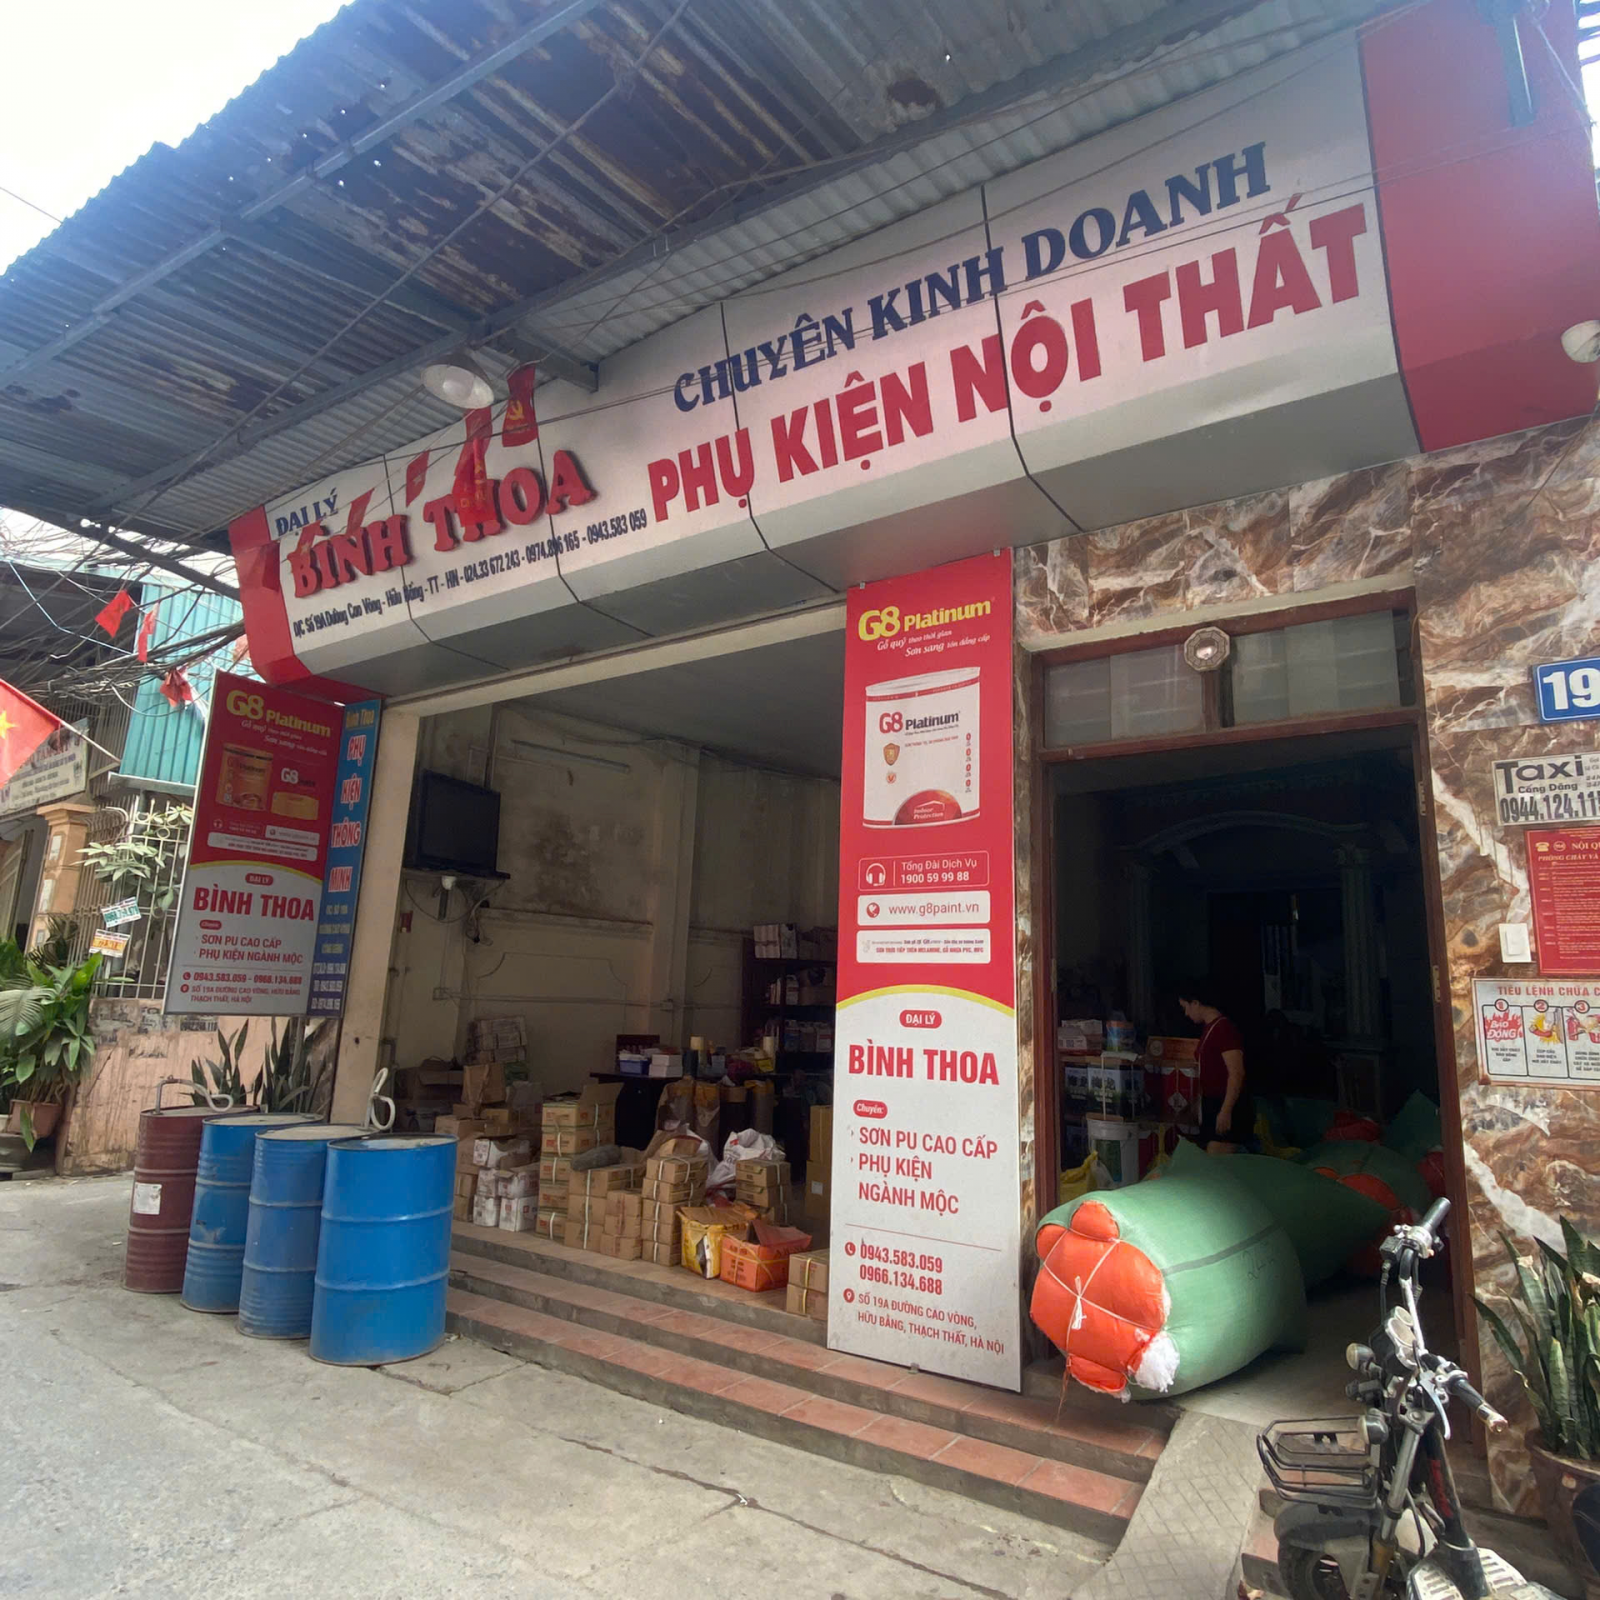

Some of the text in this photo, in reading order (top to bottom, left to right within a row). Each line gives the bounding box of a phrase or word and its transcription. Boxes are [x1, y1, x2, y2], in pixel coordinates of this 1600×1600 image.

[674, 142, 1271, 412] CHUYÊN KINH DOANH
[647, 192, 1367, 522] PHỤ KIỆN NỘI THẤT
[275, 487, 339, 537] ĐẠI LÝ
[427, 575, 439, 594] TT
[445, 568, 460, 589] HN
[564, 530, 580, 552] 165
[587, 514, 628, 545] 0943.583
[629, 508, 647, 532] 059
[858, 600, 991, 641] G8 Platinum
[1542, 667, 1600, 711] 19
[226, 690, 265, 720] G8
[265, 709, 332, 738] Platinum
[879, 712, 903, 734] G8
[905, 712, 960, 731] Platinum
[347, 735, 366, 767] PHỤ
[281, 767, 299, 785] G8
[1495, 755, 1584, 794] Taxi
[341, 772, 362, 811] KIỆN
[1500, 790, 1600, 823] 0944.124.11
[331, 817, 361, 848] THÔNG
[328, 866, 353, 892] MINH
[901, 871, 970, 884] 1900 59 99 88
[925, 859, 940, 870] Đài
[942, 858, 962, 870] Dịch
[964, 858, 977, 869] Vụ
[193, 884, 314, 921] BÌNH THOA
[888, 902, 980, 917] www.g8paint.vn
[199, 948, 304, 965] PHỤ KIỆN NGÀNH MỘC
[201, 934, 282, 949] SƠN PU CAO CẤP
[193, 972, 247, 983] 0943.583.059
[905, 1012, 935, 1026] ĐẠI LÝ
[1537, 1001, 1546, 1010] 2
[1577, 1002, 1586, 1011] 3
[849, 1039, 999, 1085] BÌNH THOA
[859, 1127, 998, 1159] SƠN PU CAO CẤP
[859, 1153, 932, 1182] PHỤ KIỆN
[859, 1180, 959, 1217] NGÀNH MỘC
[860, 1242, 943, 1273] 0943.583.059
[859, 1264, 943, 1296] 0966.134.688
[858, 1291, 977, 1330] SỐ 19A ĐƯỜNG CAO VÒNG,
[858, 1310, 877, 1325] HỮU
[909, 1322, 940, 1340] THẠCH
[942, 1329, 968, 1348] THẤT,
[970, 1335, 985, 1350] HÀ
[987, 1341, 1005, 1356] NỘI
